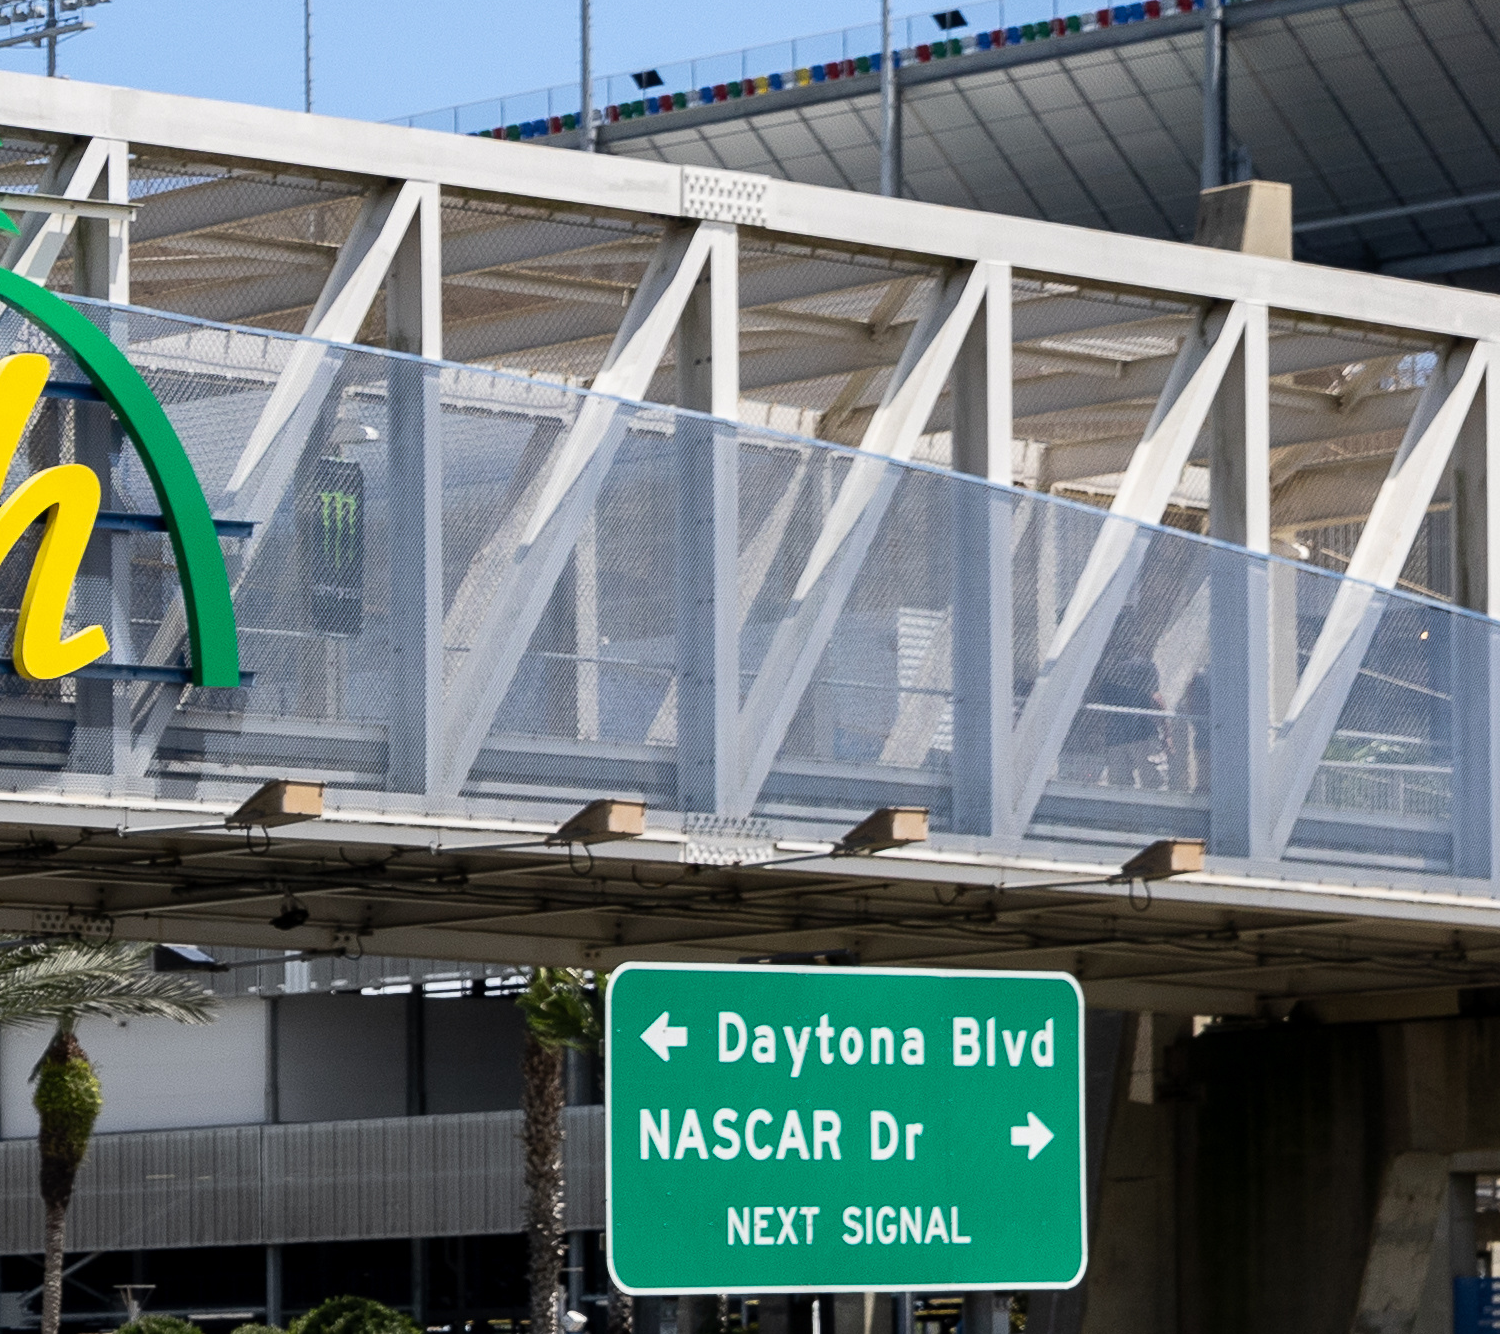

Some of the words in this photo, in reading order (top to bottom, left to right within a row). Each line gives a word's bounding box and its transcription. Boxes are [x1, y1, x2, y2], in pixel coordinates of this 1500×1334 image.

[718, 1011, 926, 1078] Daytona
[952, 1016, 1054, 1068] Blvd
[639, 1107, 842, 1161] NASCAR
[870, 1109, 925, 1161] Dr
[726, 1205, 820, 1246] NEXT
[842, 1205, 973, 1245] SIGNAL
